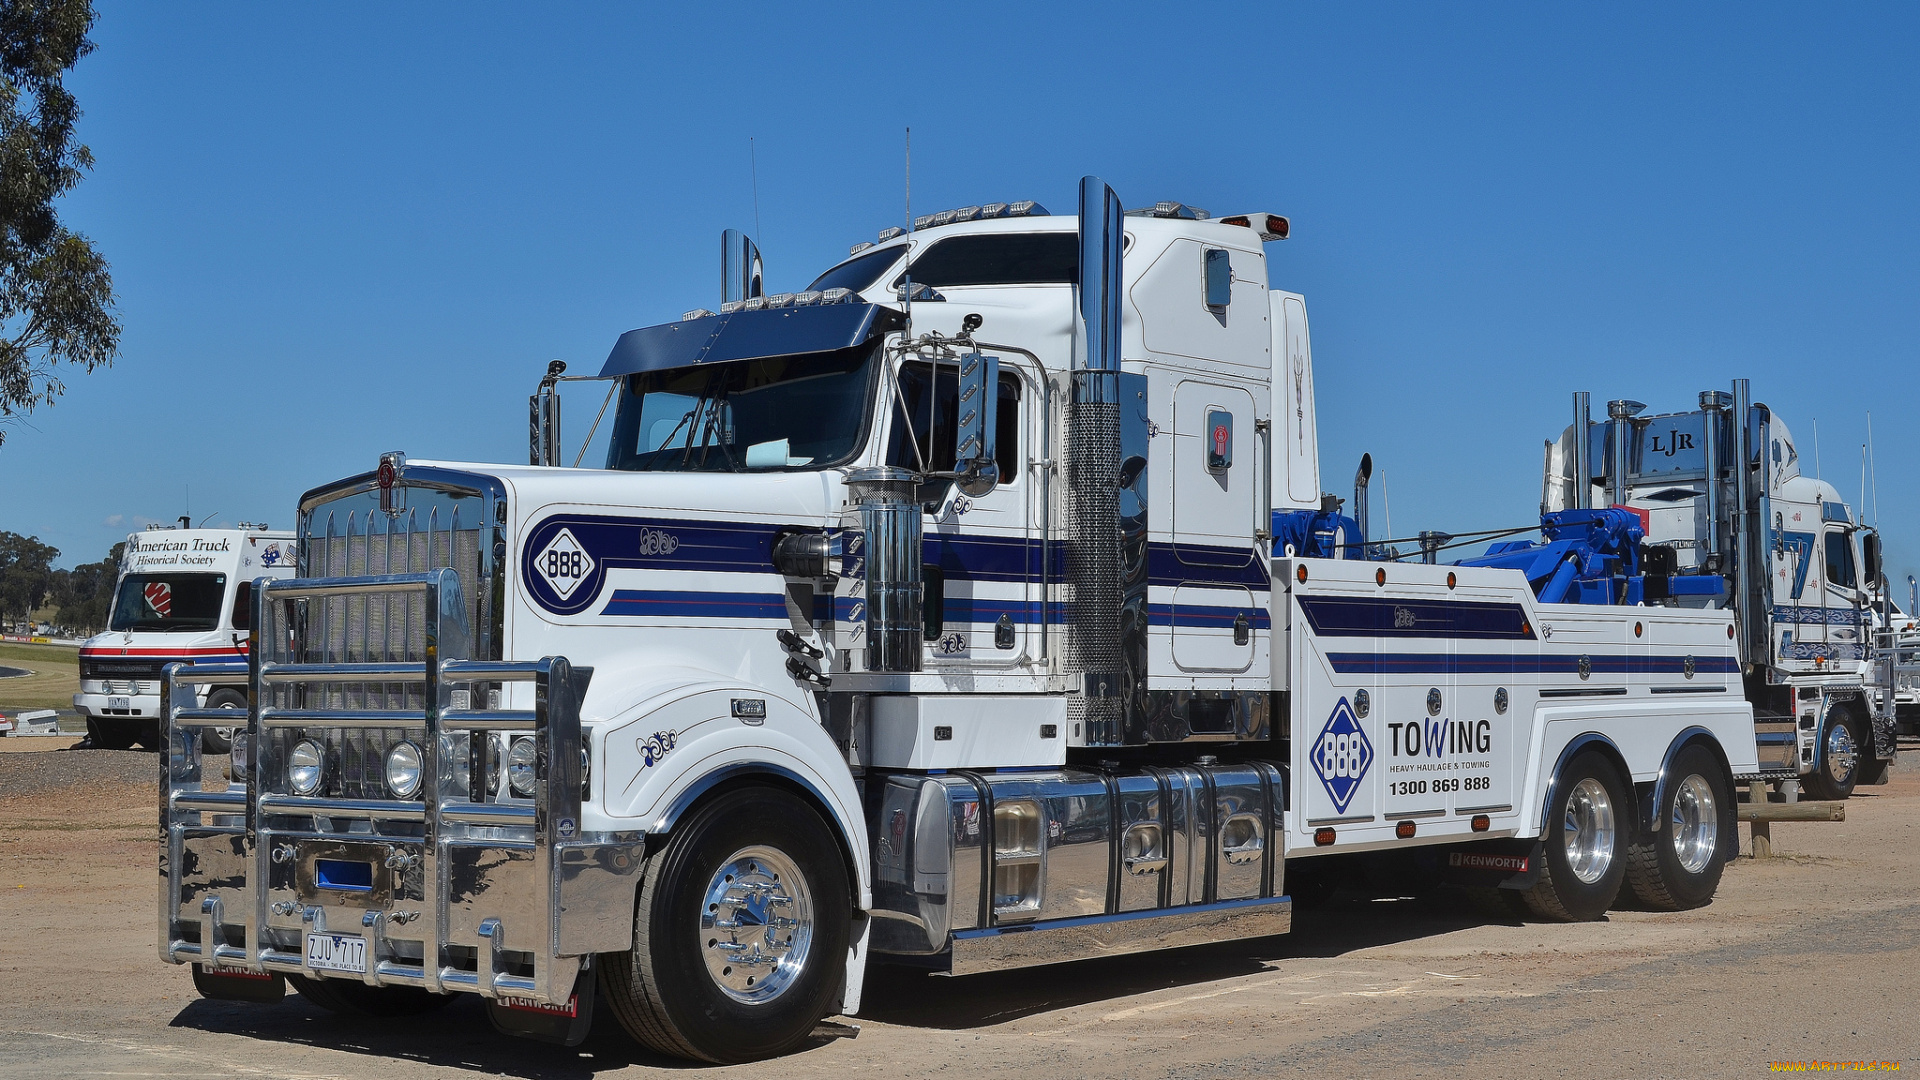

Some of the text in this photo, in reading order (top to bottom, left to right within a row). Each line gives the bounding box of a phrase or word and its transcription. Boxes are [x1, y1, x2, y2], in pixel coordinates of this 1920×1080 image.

[1651, 430, 1695, 457] LJR
[131, 538, 230, 553] American Truck
[137, 554, 216, 567] Historical Society
[547, 549, 582, 579] 888
[1388, 717, 1491, 758] TOWING
[1323, 731, 1362, 780] 888
[1389, 761, 1490, 773] HEAVY HAULAGE & TOWING
[1389, 776, 1490, 796] 1300 869 888
[1463, 855, 1526, 869] KENWORTH
[309, 938, 364, 965] ZJU 717
